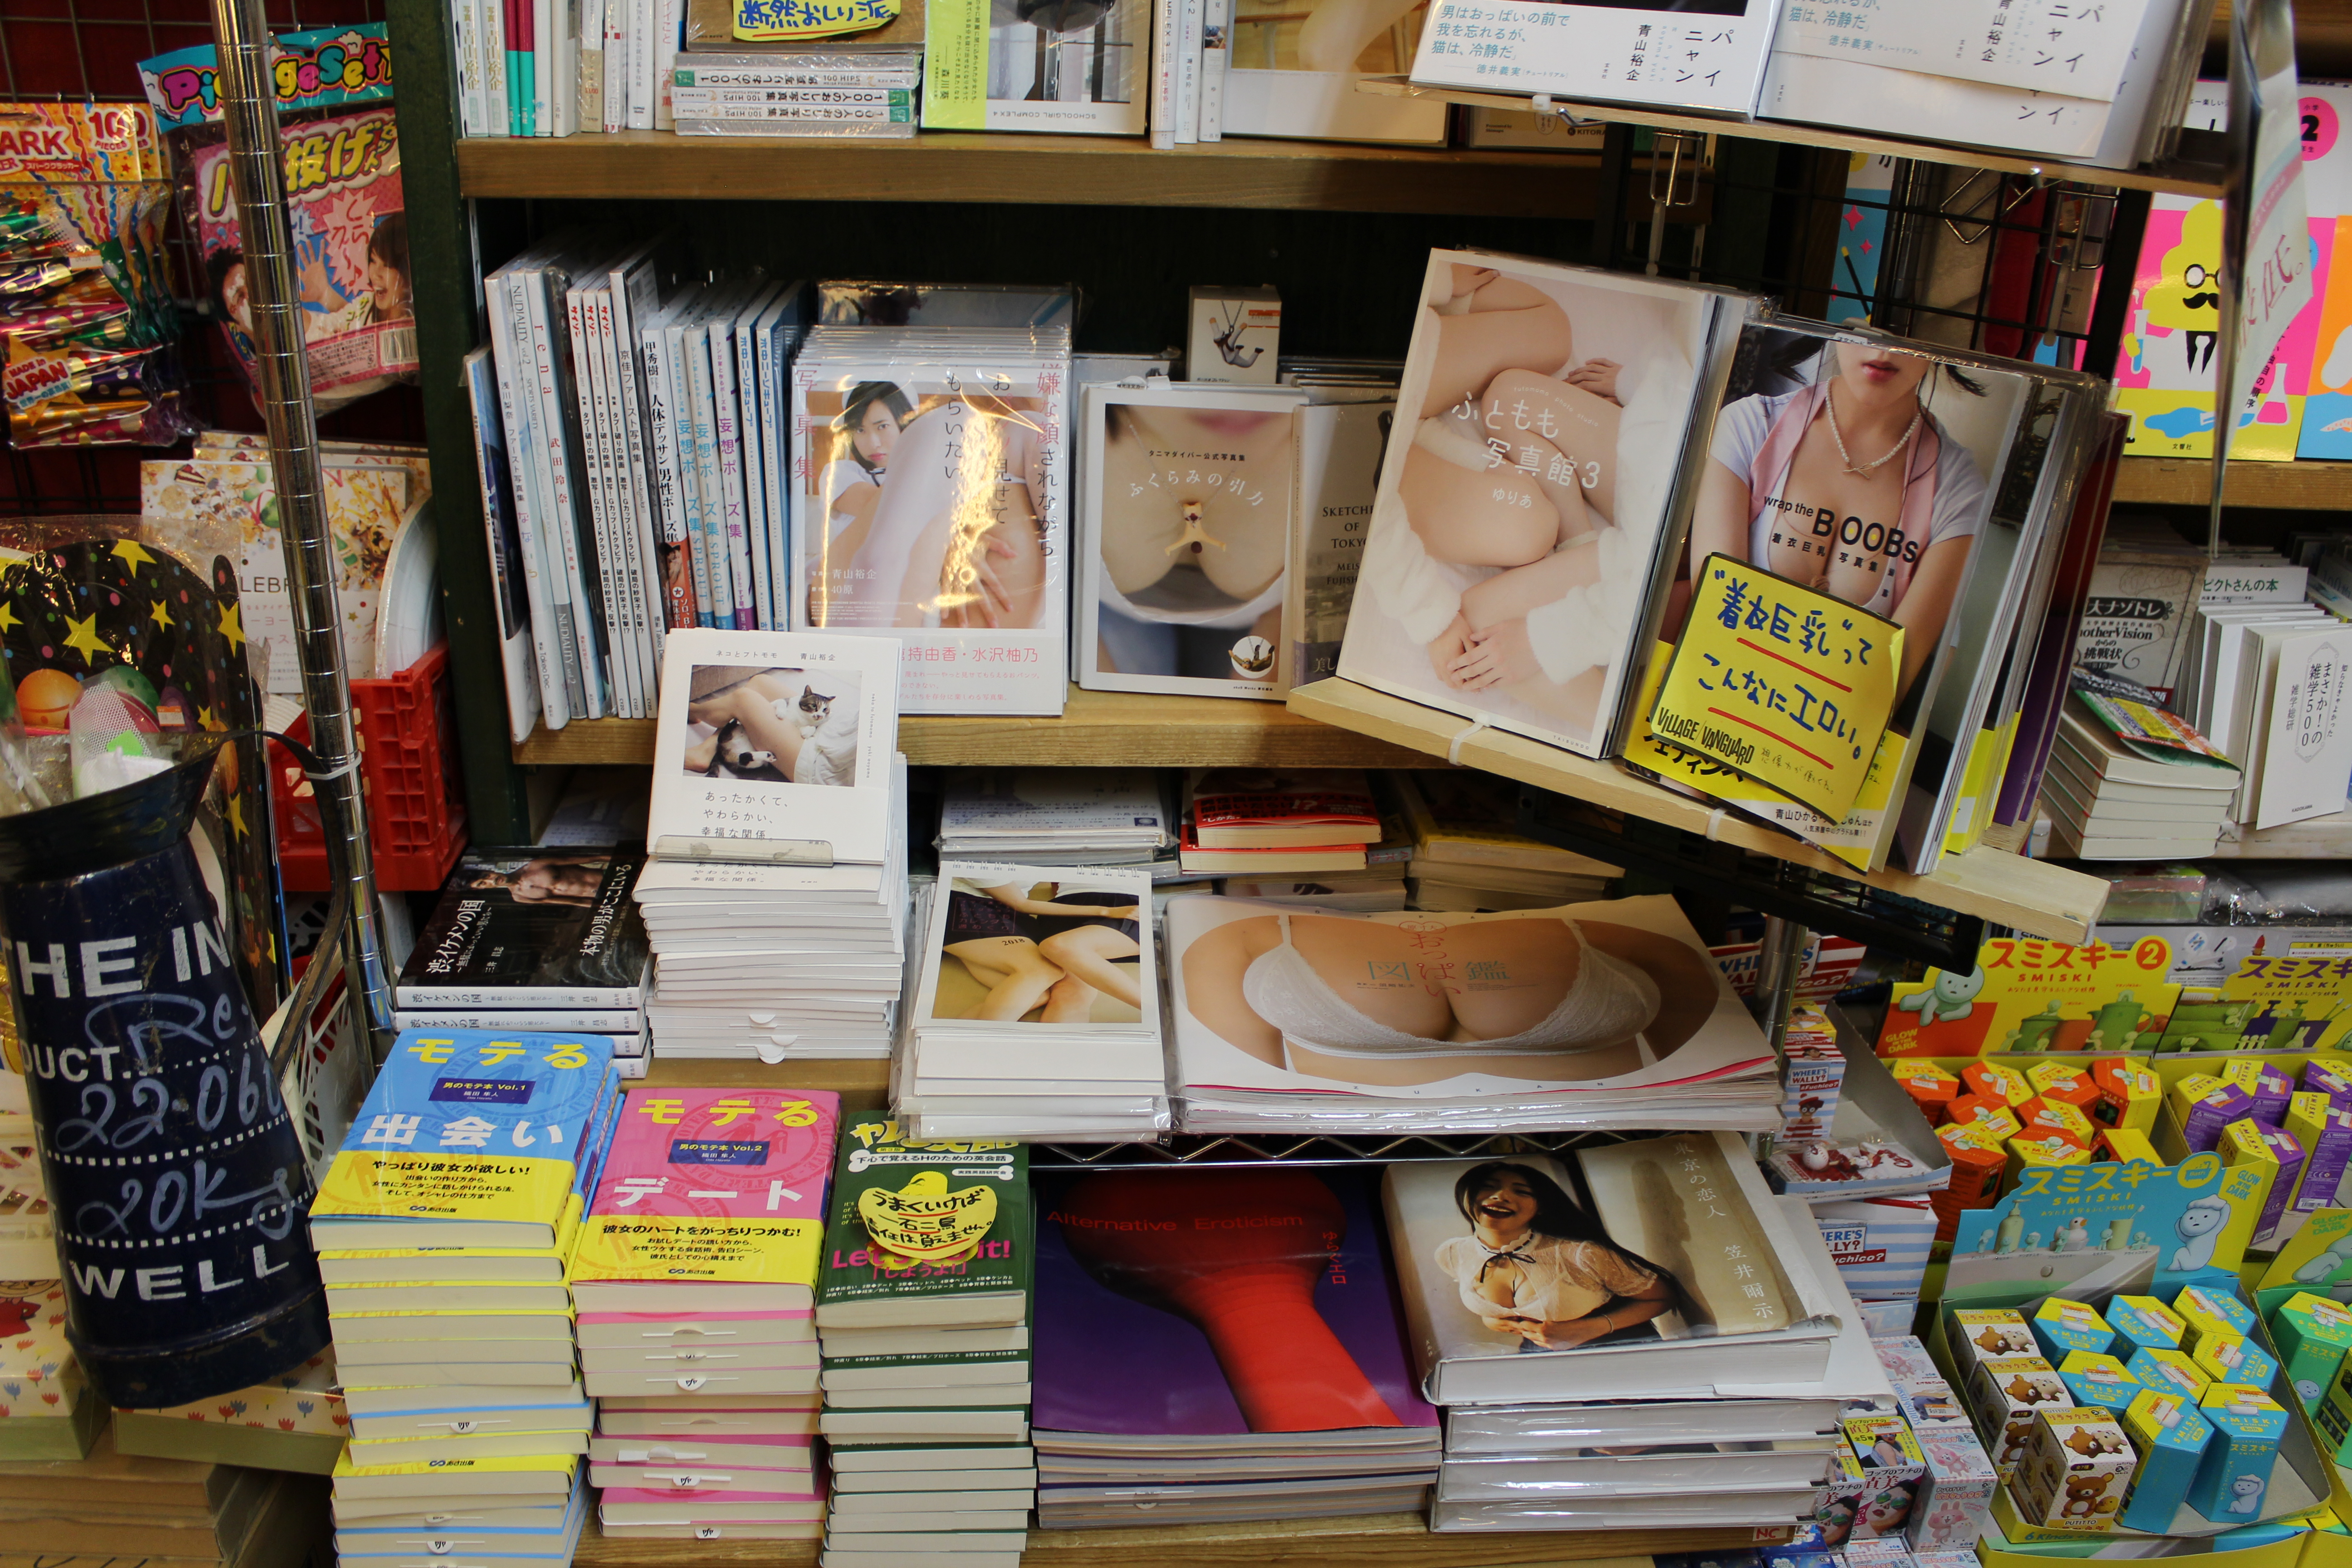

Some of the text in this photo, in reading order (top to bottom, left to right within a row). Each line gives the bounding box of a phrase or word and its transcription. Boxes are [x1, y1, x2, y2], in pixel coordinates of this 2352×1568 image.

[1436, 23, 1527, 43] 我を忘れるが、
[1788, 6, 1871, 32] 猫は、冷静だ」
[1828, 34, 1875, 52] 徳井義実
[2033, 4, 2069, 66] ニャン
[1431, 40, 1518, 61] 猫は、冷静だ」
[1625, 23, 1653, 82] 青山裕企
[1676, 30, 1704, 83] ニャン
[1476, 64, 1523, 77] 徳井義実
[2301, 114, 2320, 142] 2
[512, 284, 528, 344] NUDIALITY
[9, 361, 35, 377] MADE
[534, 323, 553, 395] rena
[645, 341, 659, 377] 甲秀樹
[6, 361, 69, 400] JAPAN
[619, 349, 643, 464] 京佳ファースト写真集
[1451, 391, 1559, 439] ふともも
[1554, 397, 1574, 412] photo
[1577, 412, 1599, 427] studio
[650, 394, 669, 466] 人体デッサン
[794, 368, 818, 481] 写真集
[944, 371, 964, 480] もらいたい
[500, 381, 526, 502] 浅川梨奈 ファースト写真集
[583, 412, 596, 470] タブー破りの映画
[598, 412, 611, 470] タブー破りの映画
[612, 412, 625, 470] タブー破りの映画
[1149, 449, 1247, 462] タニマダイバー公式写真集
[550, 437, 568, 505] 武田玲奈
[719, 418, 743, 538] 妄想ポーズ集
[1035, 370, 1062, 558] 嫌な顔されながら
[1129, 469, 1264, 507] ふくらみの引力
[1492, 488, 1532, 509] ゆりあ
[676, 418, 710, 600] 妄想ポーズ集 SPROUT
[695, 423, 725, 605] 妄想ポーズ集 SPROUT
[1344, 522, 1360, 532] OF
[1764, 495, 1920, 563] wrap the BOOBS
[2203, 578, 2279, 593] ピクトさんの本
[2086, 599, 2161, 617] 大ナゾトレ
[558, 613, 574, 666] NUDIALITY
[2084, 647, 2123, 660] 挑戦状
[715, 650, 779, 659] ネコとフトモモ
[1697, 653, 1862, 760] こんなにエロい。
[2300, 663, 2323, 747] 雑学500
[2311, 662, 2333, 745] まさか!の
[2326, 664, 2348, 738] 知らなきゃよかった
[705, 790, 789, 808] あったかくて、
[703, 808, 774, 824] やわらかい、
[579, 863, 632, 957] 本物の男がここにいる
[426, 899, 486, 975] 渋イケメンの国
[1002, 937, 1026, 947] 2018
[1409, 932, 1462, 997] おっぱい
[1986, 940, 2129, 970] スミスキー
[2018, 973, 2092, 983] SMISKI
[412, 993, 483, 1004] 渋イケメンの国
[410, 1018, 480, 1029] 渋イケメンの国
[1885, 1028, 1919, 1044] GLOW
[407, 1038, 588, 1070] モテる
[1887, 1040, 1918, 1055] DARK
[443, 1081, 494, 1090] 男のモテ本
[1791, 1073, 1827, 1085] WALLY?
[1792, 1067, 1828, 1078] WHERE'S
[638, 1098, 819, 1127] モテる
[361, 1114, 564, 1149] 出会い
[679, 1143, 729, 1152] 男のモテ本
[856, 1154, 1007, 1163] 下心で覚えるHのための英会話
[372, 1160, 531, 1175] やっぱり彼女が欲しい!
[1672, 1141, 1727, 1220] 東京の恋人
[2020, 1165, 2173, 1196] スミスキー
[2237, 1169, 2263, 1185] GLOW
[385, 1190, 495, 1200] そして、オシャレの仕方まで
[613, 1176, 804, 1211] デート
[872, 1187, 986, 1213] うまくいけば
[2052, 1192, 2132, 1207] SMISKI
[2225, 1184, 2252, 1201] DARK
[603, 1225, 801, 1237] 彼女のハートをがっちりつかむ!
[877, 1213, 956, 1232] 一石二鳥
[1046, 1210, 1303, 1232] Alternative Eroticism
[649, 1253, 745, 1262] 彼氏としての心構えまで
[68, 1245, 290, 1302] WELL
[1723, 1244, 1774, 1319] 笠井爾示
[446, 1459, 475, 1467] あさ出版
[1865, 1467, 1923, 1477] コップのフチの
[1755, 1526, 1780, 1541] NC
